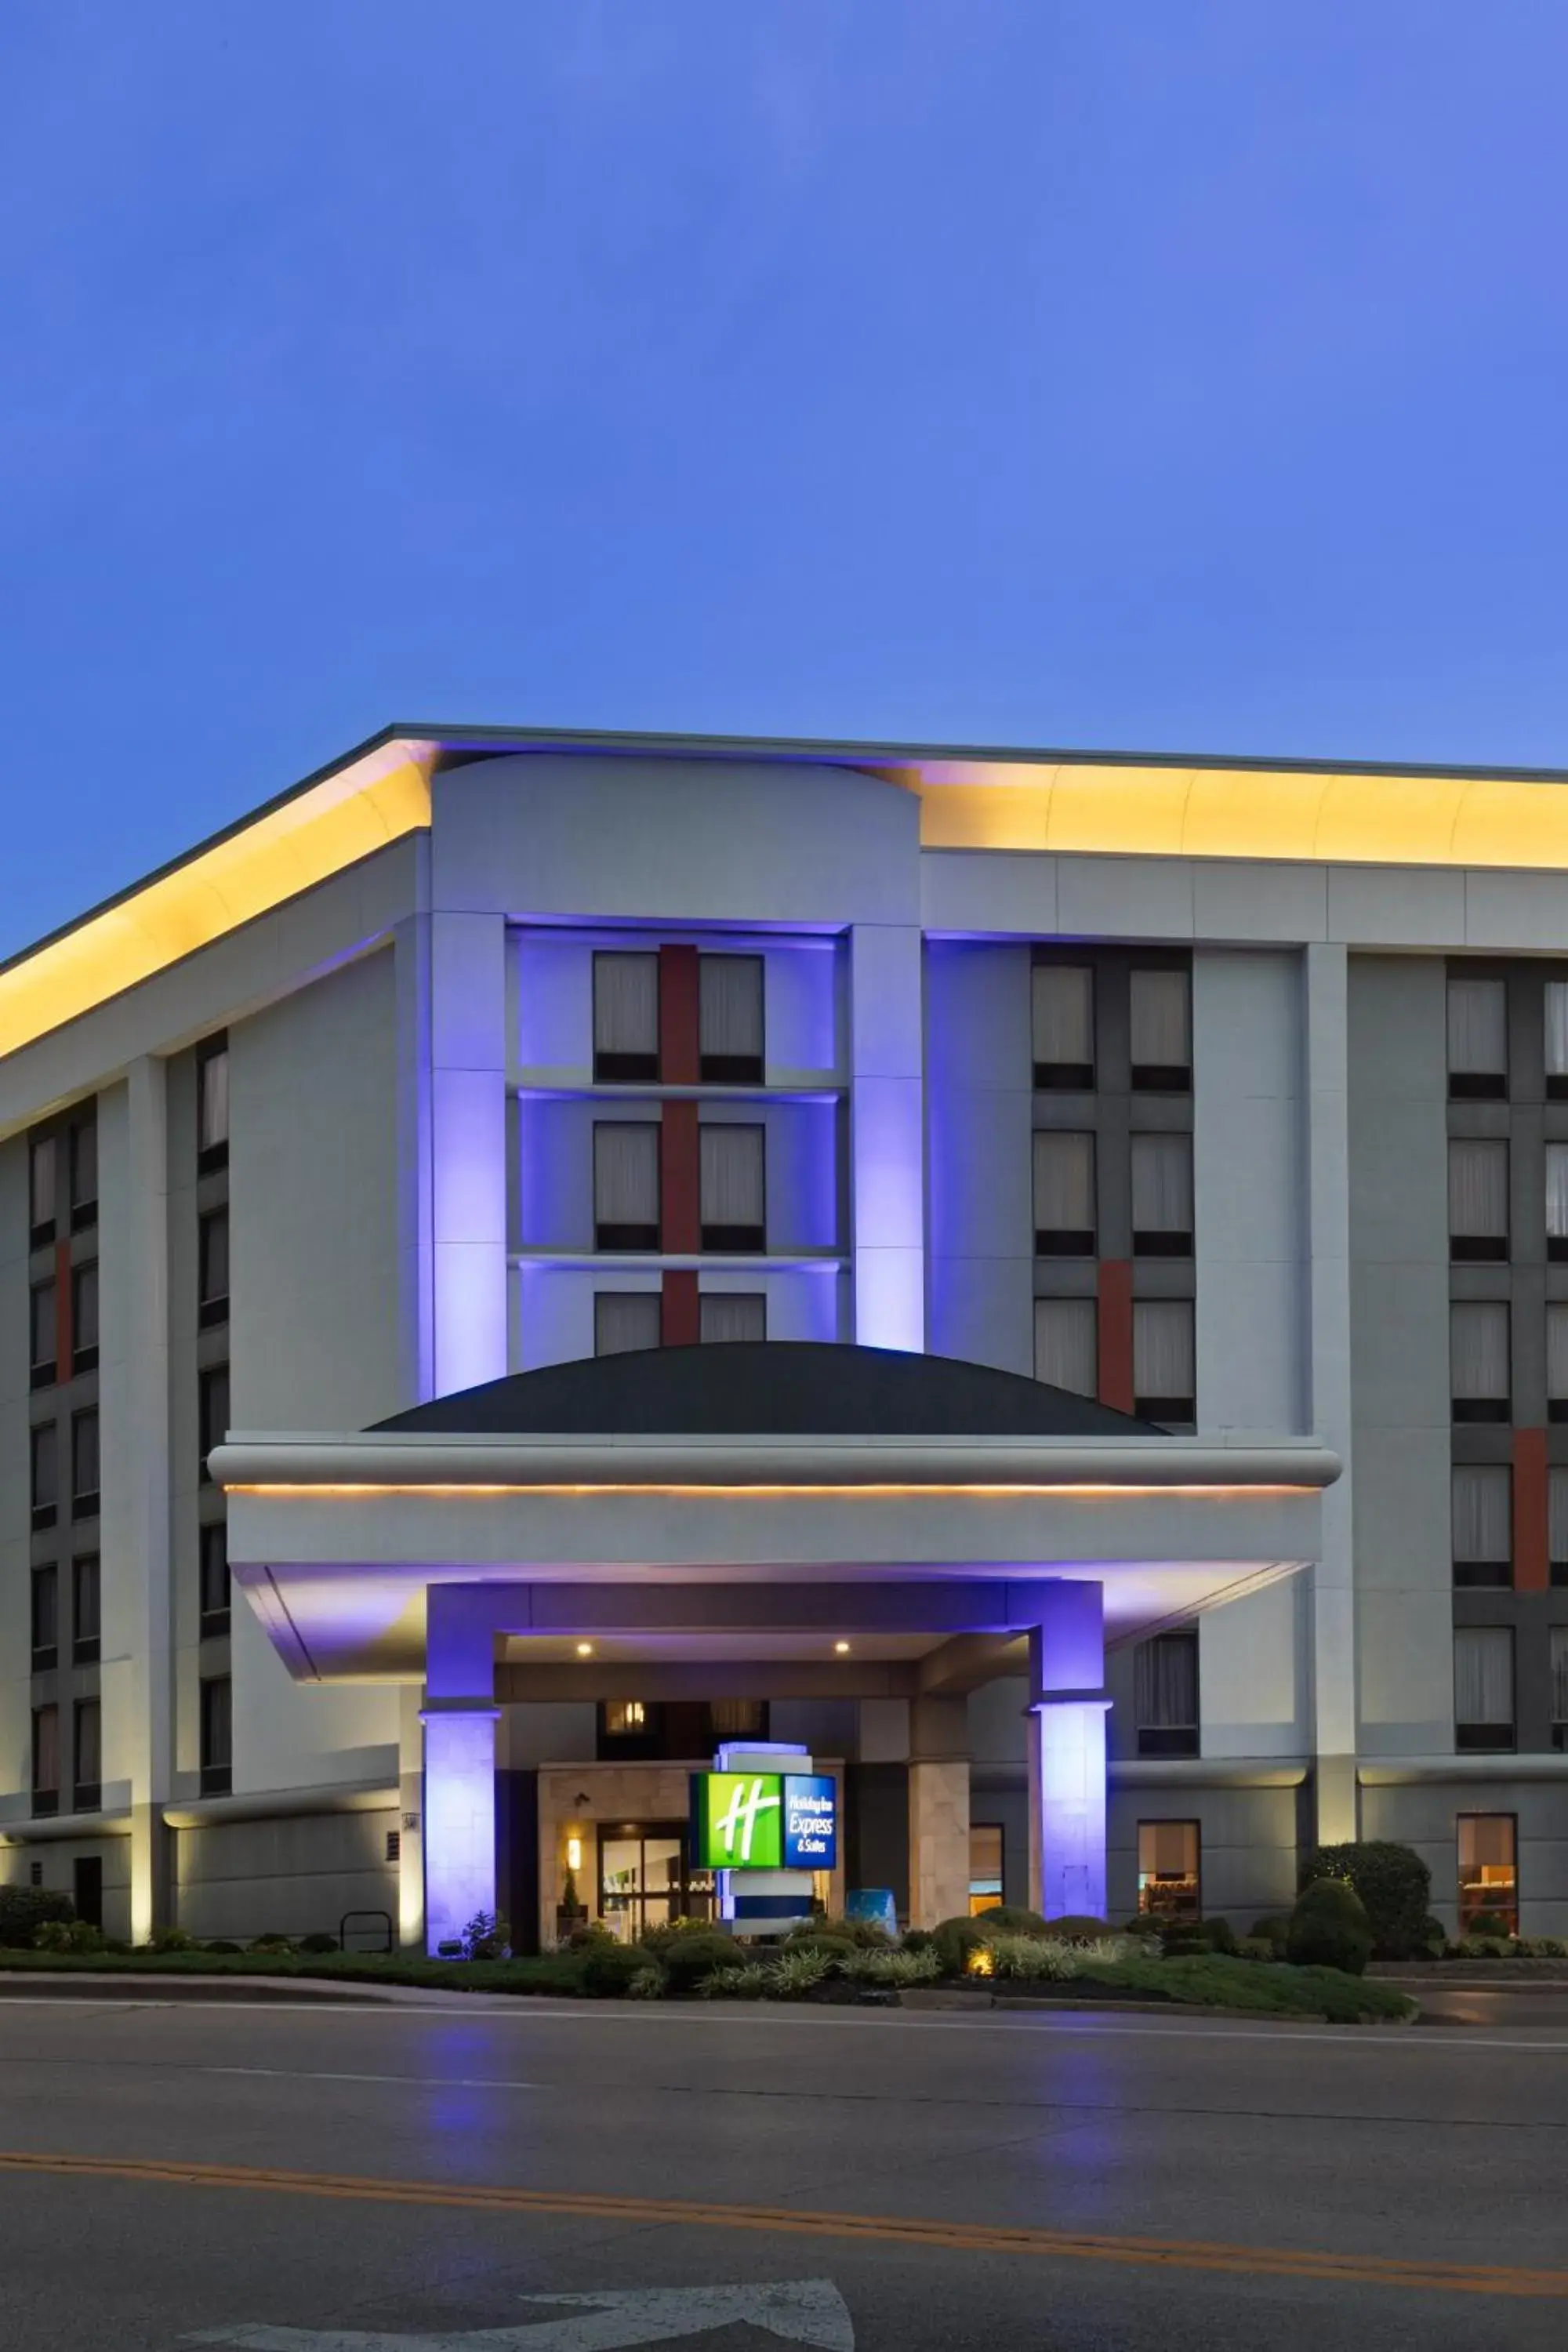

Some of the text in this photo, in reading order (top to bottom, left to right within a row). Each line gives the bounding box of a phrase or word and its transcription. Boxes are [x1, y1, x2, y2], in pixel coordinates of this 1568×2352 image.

[715, 1778, 780, 1860] H
[789, 1813, 833, 1838] Express
[806, 1839, 826, 1853] Suites
